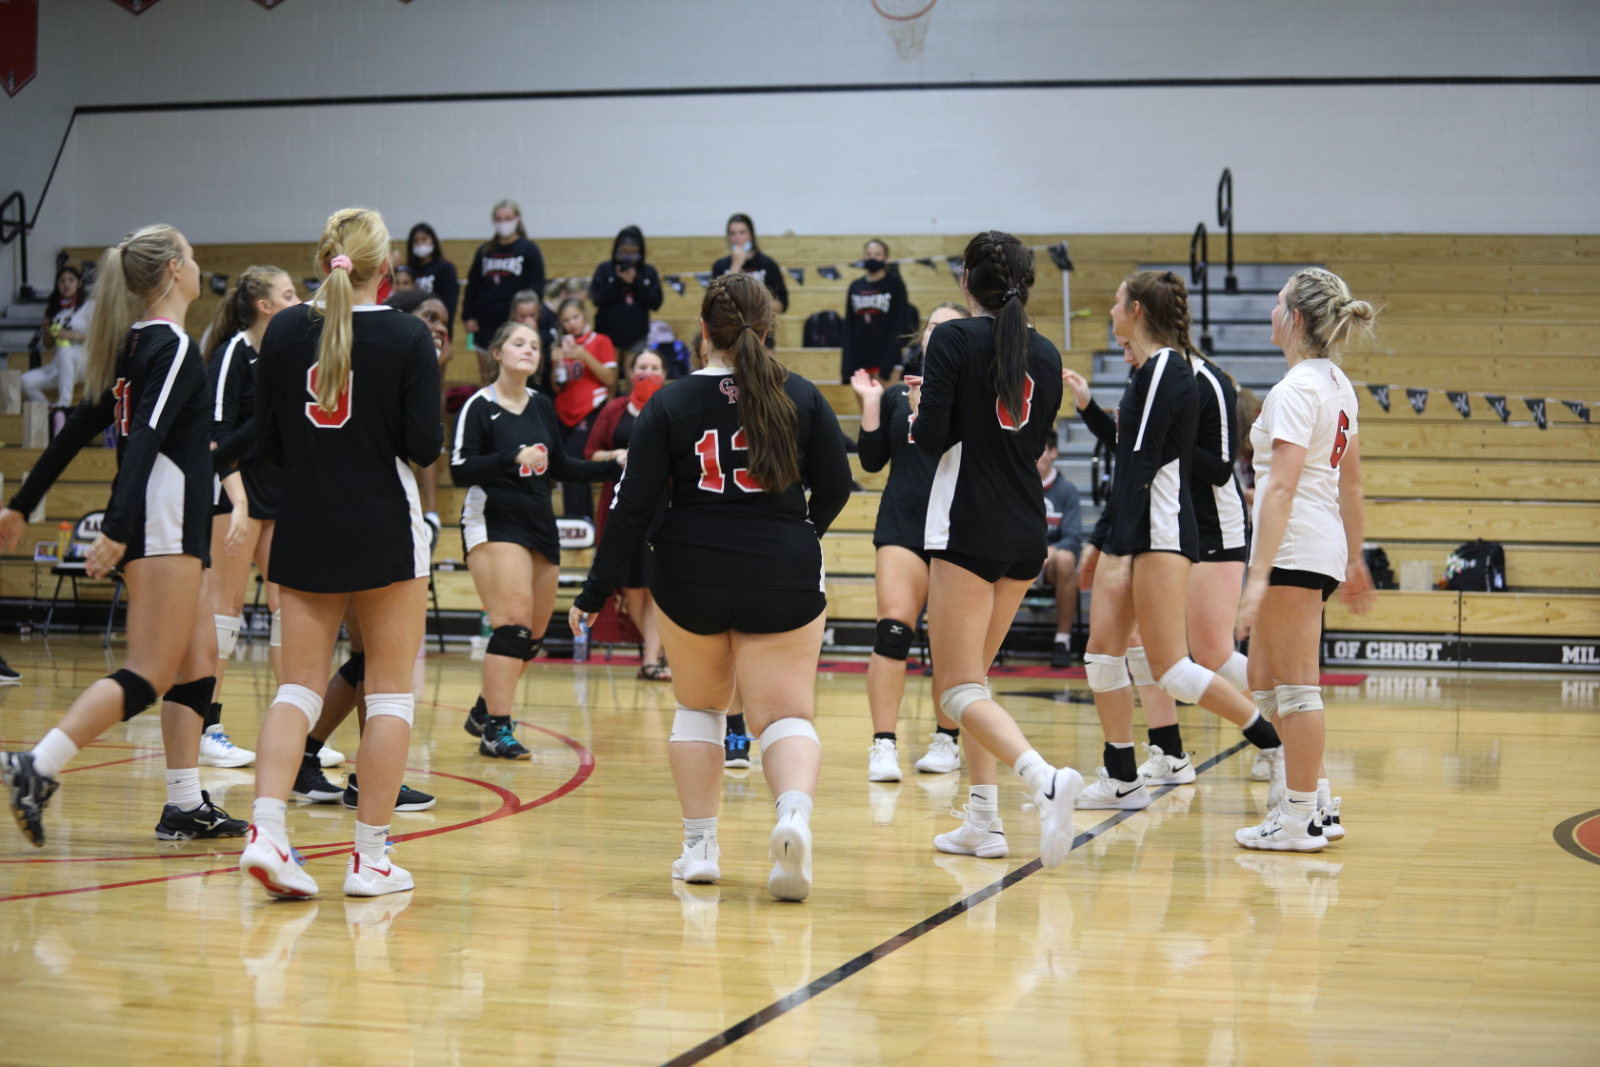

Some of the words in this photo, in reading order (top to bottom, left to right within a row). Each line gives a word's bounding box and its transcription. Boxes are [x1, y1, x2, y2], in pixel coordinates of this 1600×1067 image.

[305, 360, 354, 429] 9
[1329, 408, 1350, 469] 6
[1334, 640, 1361, 659] OF
[1365, 641, 1443, 661] CHRIST
